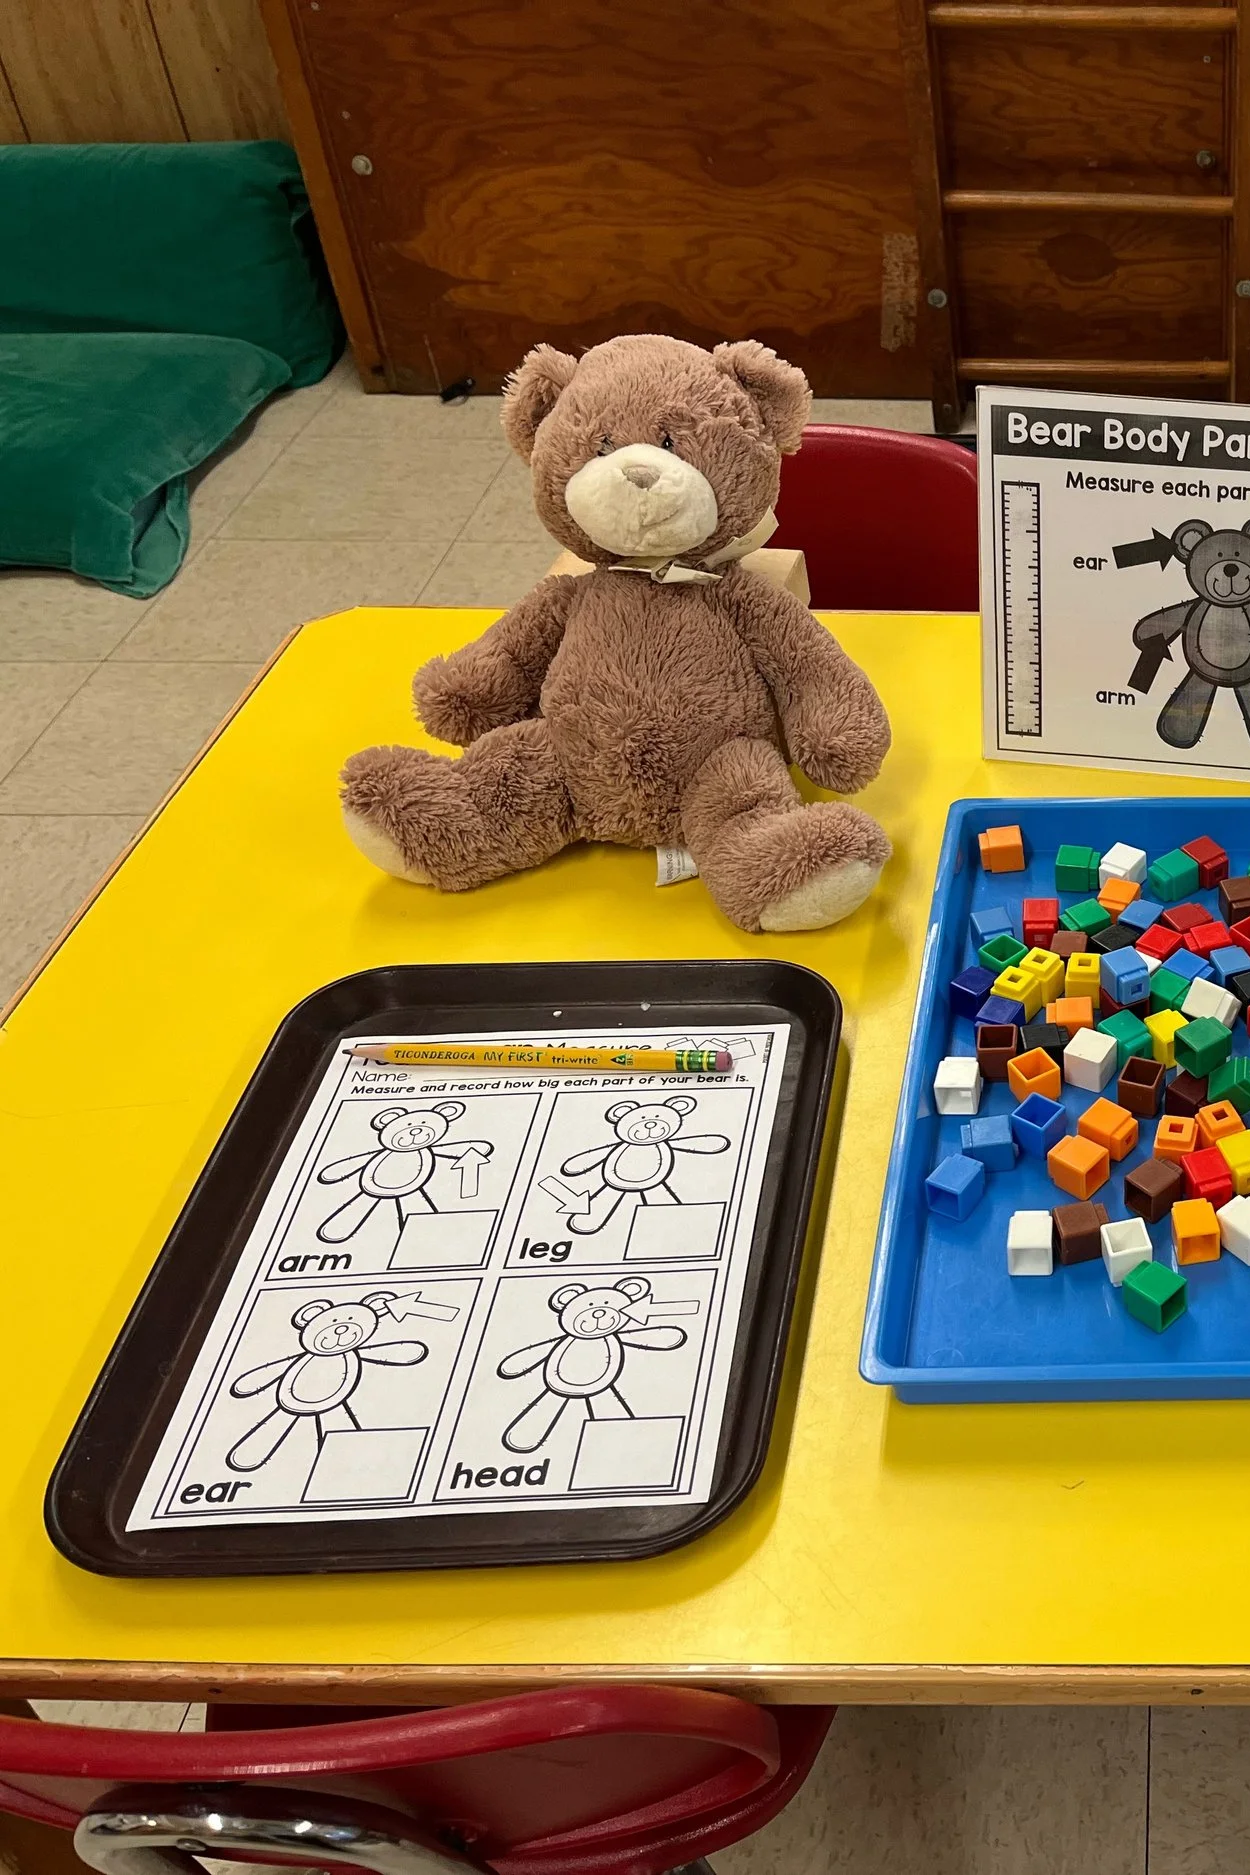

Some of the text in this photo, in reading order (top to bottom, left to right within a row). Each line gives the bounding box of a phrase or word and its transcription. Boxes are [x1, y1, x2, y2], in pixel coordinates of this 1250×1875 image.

[1009, 413, 1091, 447] Bear
[1105, 419, 1190, 461] Body
[1066, 471, 1154, 493] Measure
[1162, 480, 1209, 498] each
[1073, 557, 1108, 570] ear
[1096, 691, 1135, 705] arm
[394, 1050, 475, 1059] TICONDEROGA
[484, 1052, 503, 1061] MY
[508, 1052, 542, 1062] FIRST
[552, 1056, 598, 1065] tri-write
[351, 1071, 412, 1082] Name:
[351, 1086, 415, 1094] Measure
[420, 1084, 446, 1092] and
[450, 1082, 501, 1091] record
[504, 1081, 534, 1089] how
[539, 1080, 559, 1088] big
[564, 1077, 599, 1086] each
[602, 1077, 634, 1087] part
[639, 1076, 655, 1084] of
[660, 1076, 692, 1085] your
[736, 1074, 749, 1082] is.
[519, 1238, 572, 1262] leg
[278, 1251, 352, 1272] arm
[450, 1459, 550, 1489] head
[181, 1482, 252, 1504] ear
